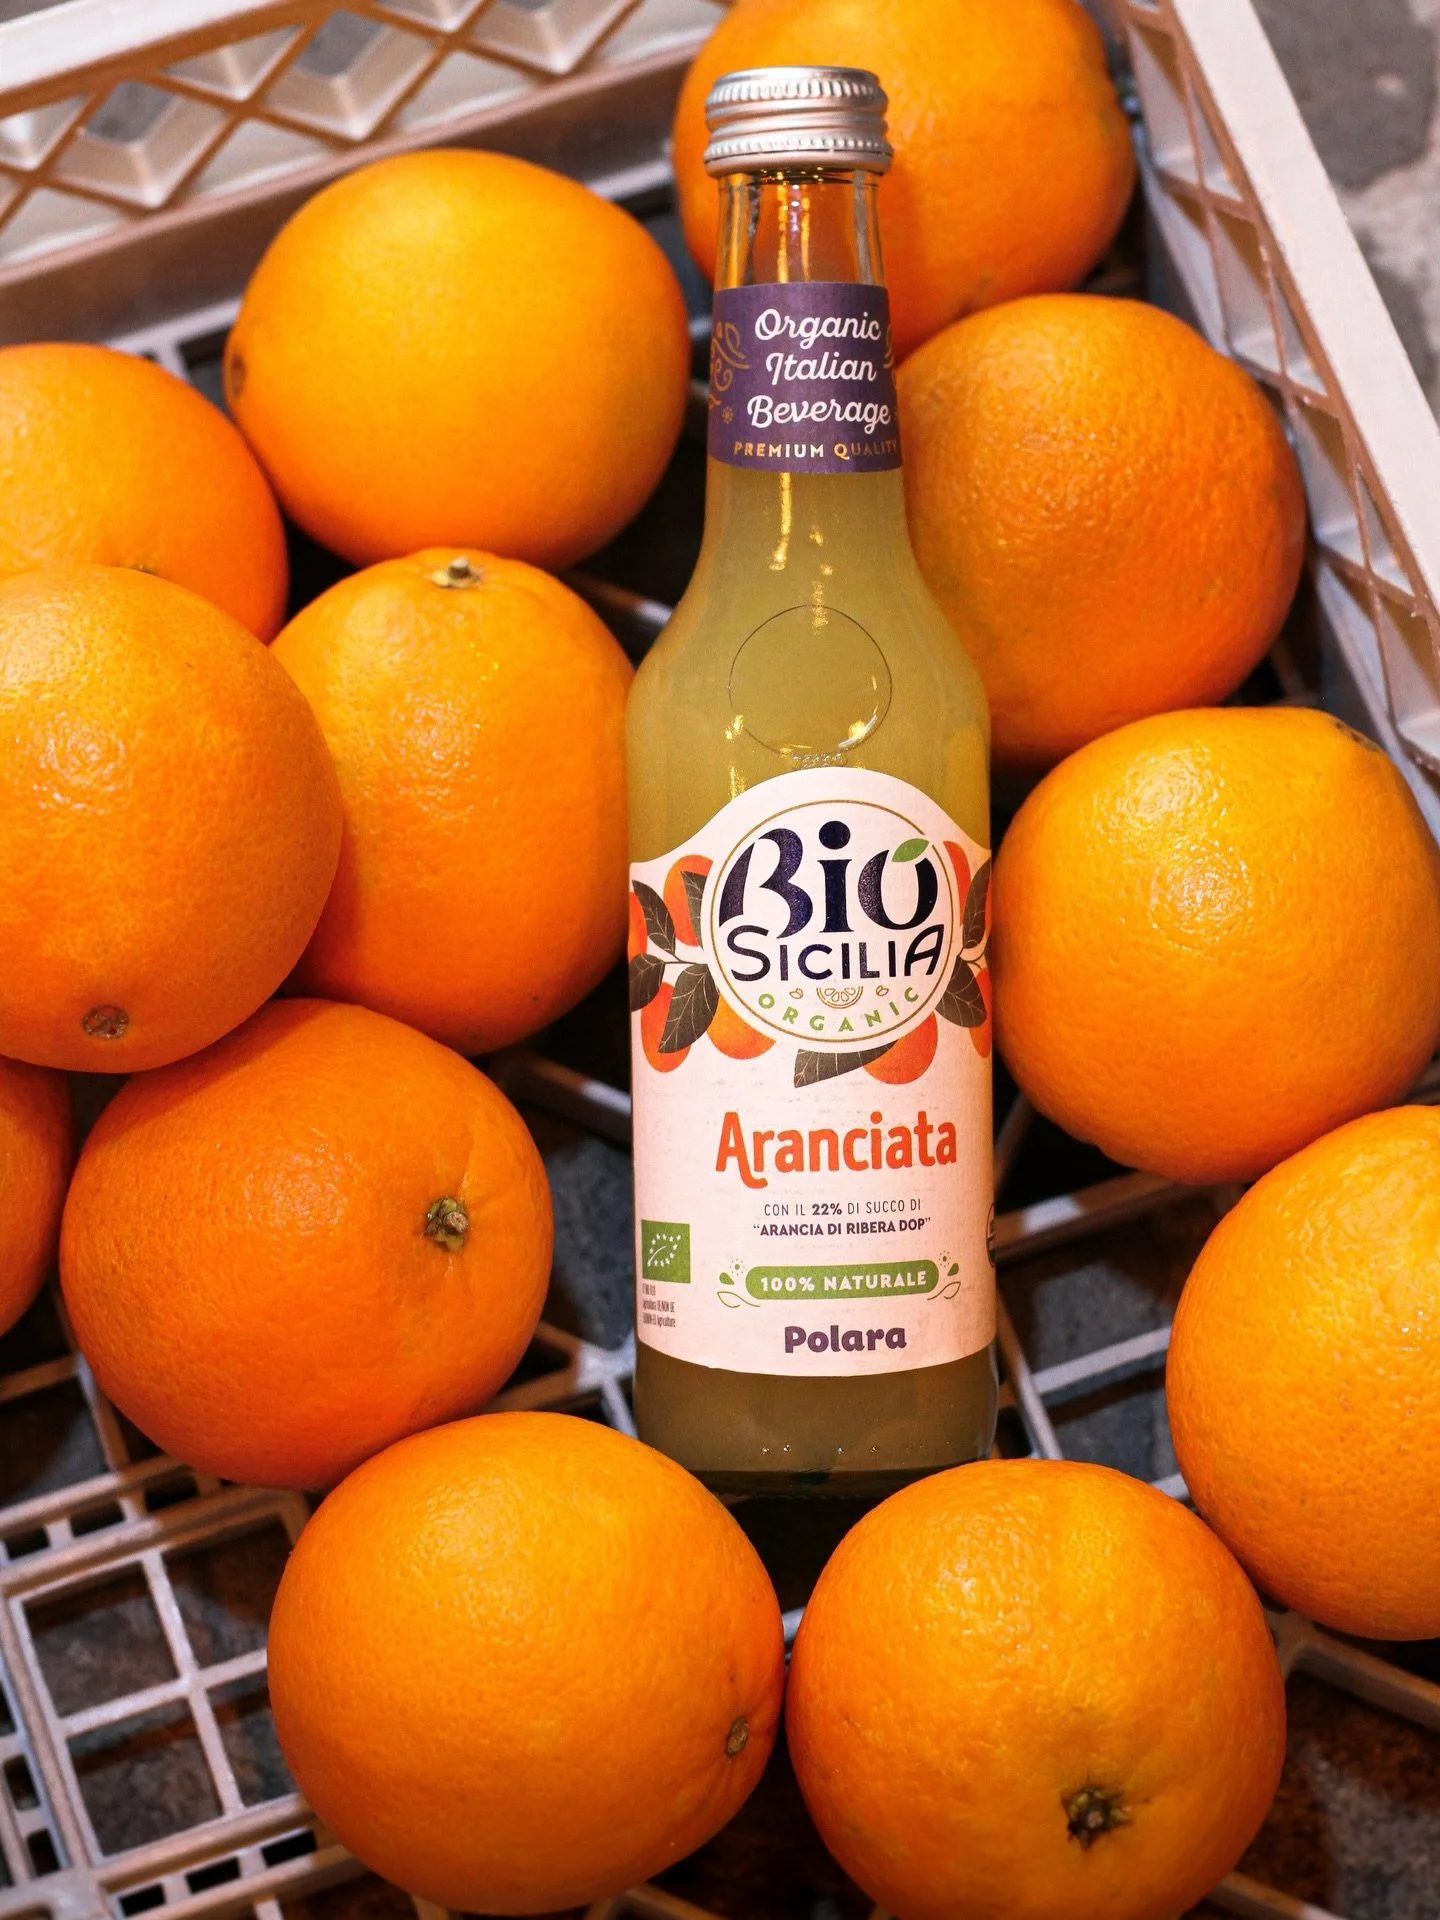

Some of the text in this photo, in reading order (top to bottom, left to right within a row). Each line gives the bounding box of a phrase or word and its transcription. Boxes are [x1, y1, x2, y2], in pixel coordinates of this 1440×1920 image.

[754, 308, 881, 350] Organic
[765, 351, 878, 386] Italian
[746, 394, 891, 435] Beverage
[733, 439, 898, 460] PREMIUM QUALITY
[757, 986, 920, 1033] ORGANIC
[715, 1110, 958, 1189] Aranciata
[763, 1197, 922, 1217] CON IL 22% DI SUCCO DI
[828, 1222, 843, 1235] DI
[847, 1221, 897, 1235] RIBERA
[760, 1270, 928, 1293] 100% NATURALE
[784, 1324, 908, 1354] Polara
